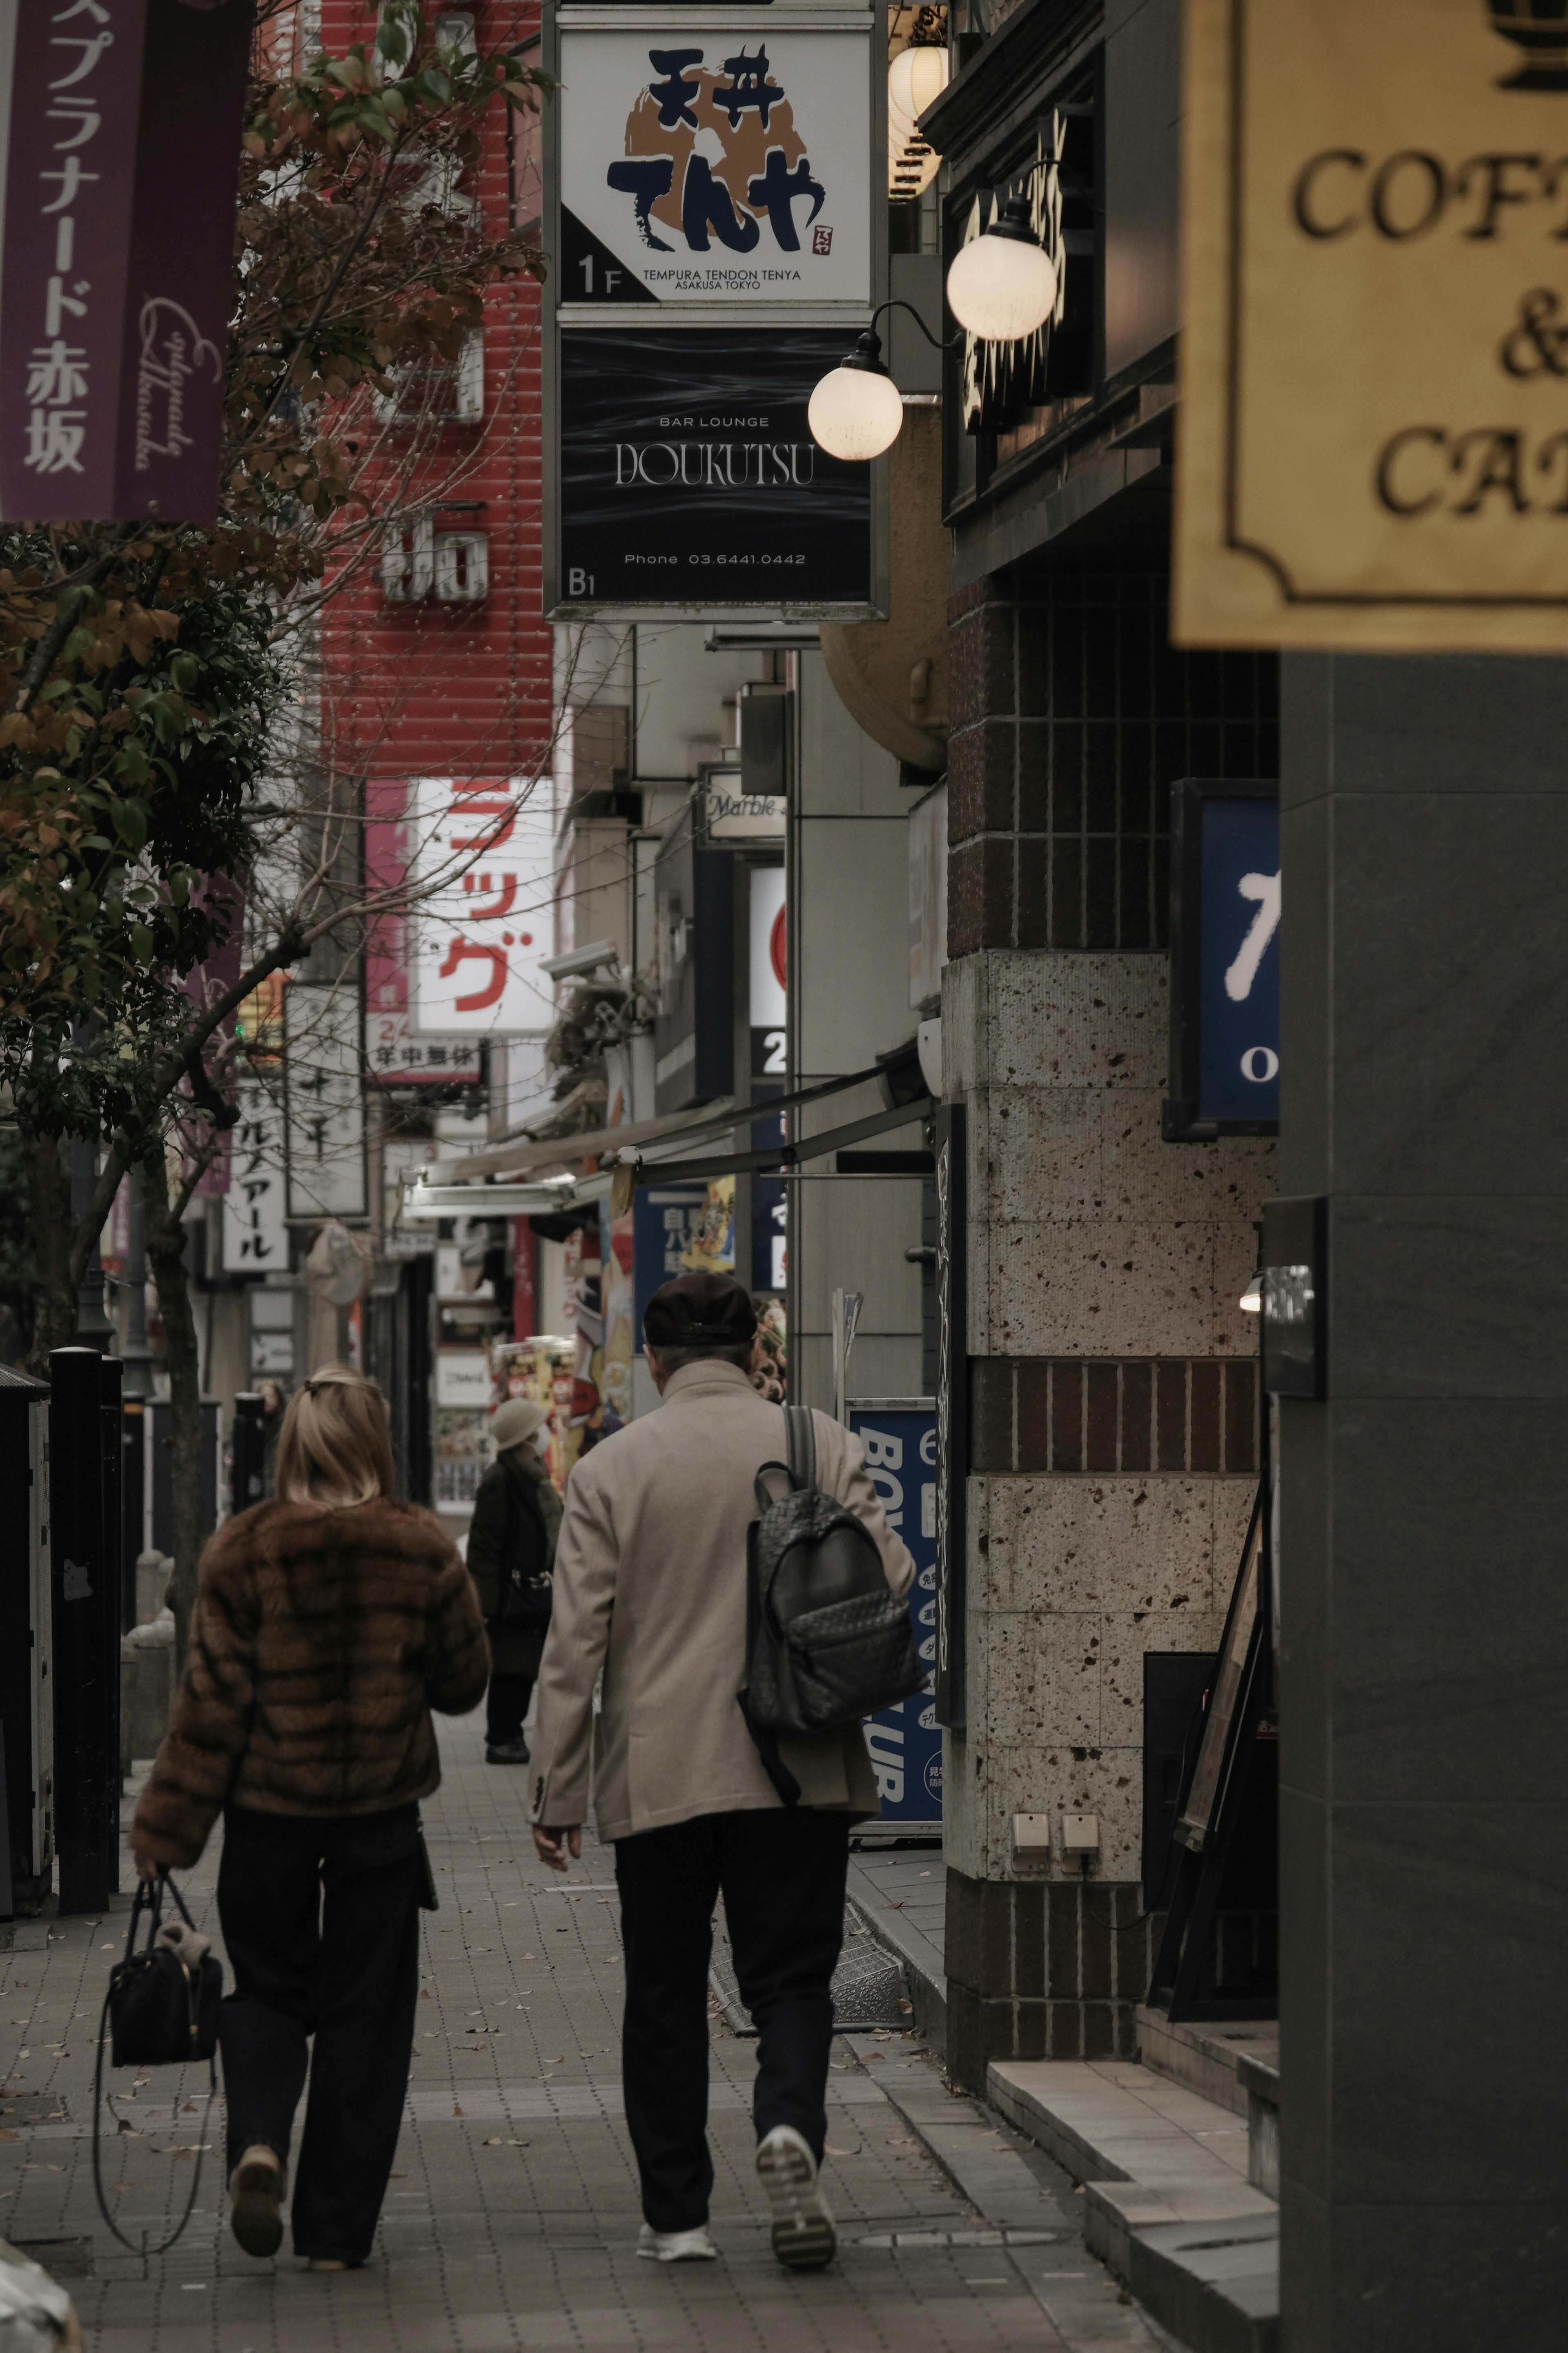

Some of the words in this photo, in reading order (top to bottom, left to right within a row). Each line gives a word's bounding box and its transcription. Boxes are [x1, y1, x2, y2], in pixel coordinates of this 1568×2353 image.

[607, 150, 826, 253] てんや
[1290, 149, 1568, 242] COF
[578, 254, 621, 294] 1F
[644, 270, 701, 280] TEMPURA
[705, 270, 758, 280] TENDON
[762, 270, 801, 280] TENYA
[675, 281, 722, 290] ASAKUSA
[725, 281, 761, 290] TOKYO
[659, 417, 694, 427] BAR
[699, 417, 769, 427] LOUNGE
[615, 443, 815, 485] DOUKUTSU
[1373, 426, 1568, 519] CA
[625, 554, 678, 564] Phone
[689, 554, 806, 564] 03.6441.0442
[569, 568, 595, 595] B1
[708, 794, 775, 816] Marble
[922, 1712, 936, 1726] テク
